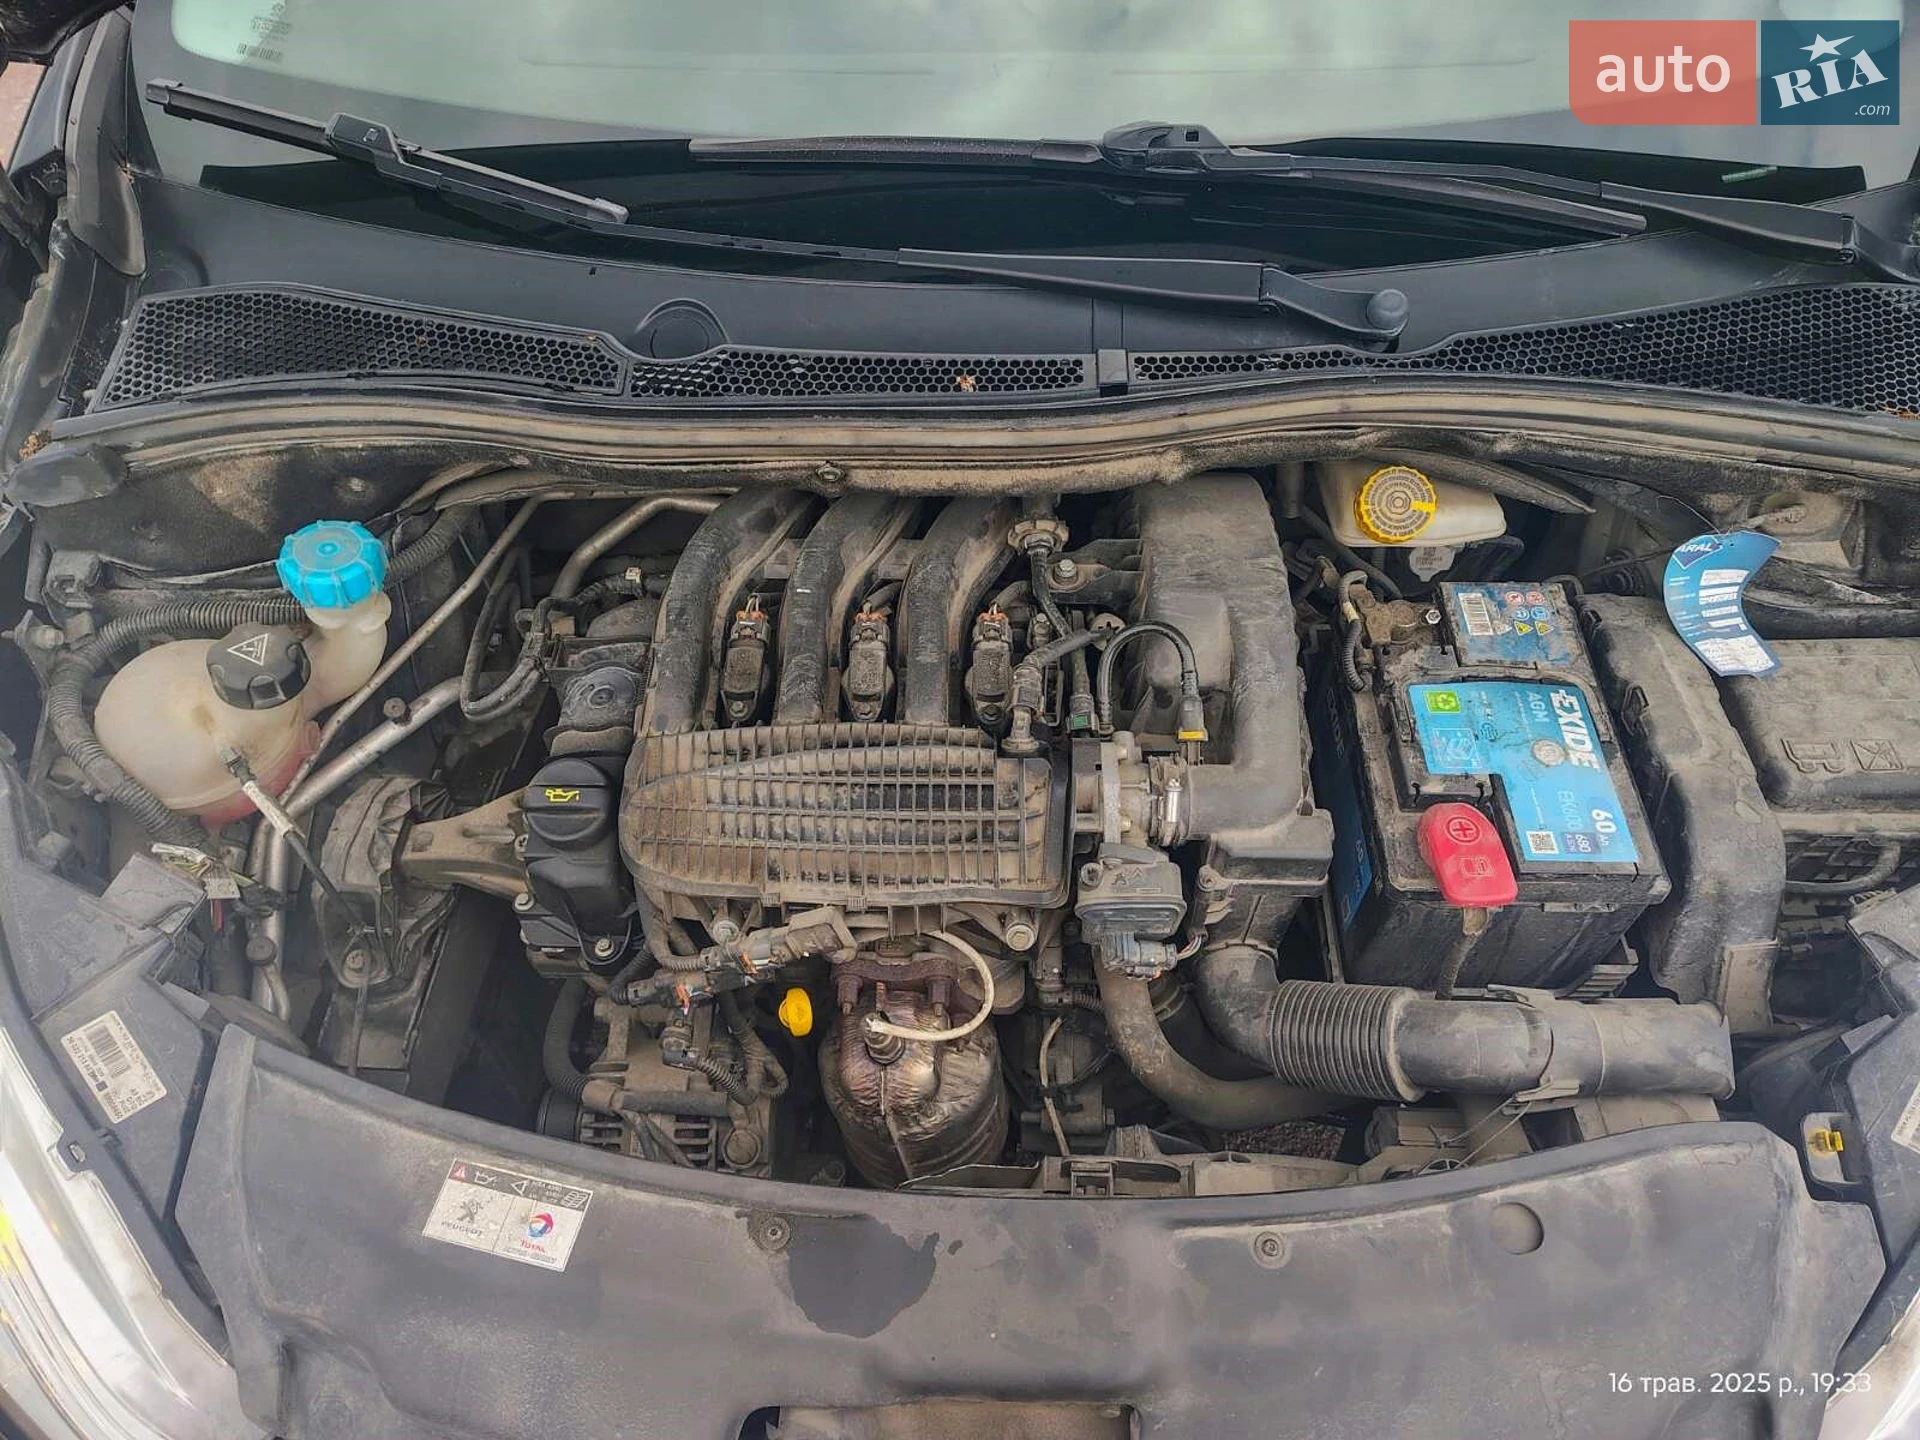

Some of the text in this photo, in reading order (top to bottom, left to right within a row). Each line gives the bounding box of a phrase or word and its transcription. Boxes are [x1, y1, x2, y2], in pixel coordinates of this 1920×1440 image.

[1679, 543, 1712, 552] ARAL
[1526, 692, 1549, 722] AGM
[1551, 689, 1600, 770] EXIDE
[1591, 808, 1617, 834] 60
[1575, 834, 1592, 853] 680
